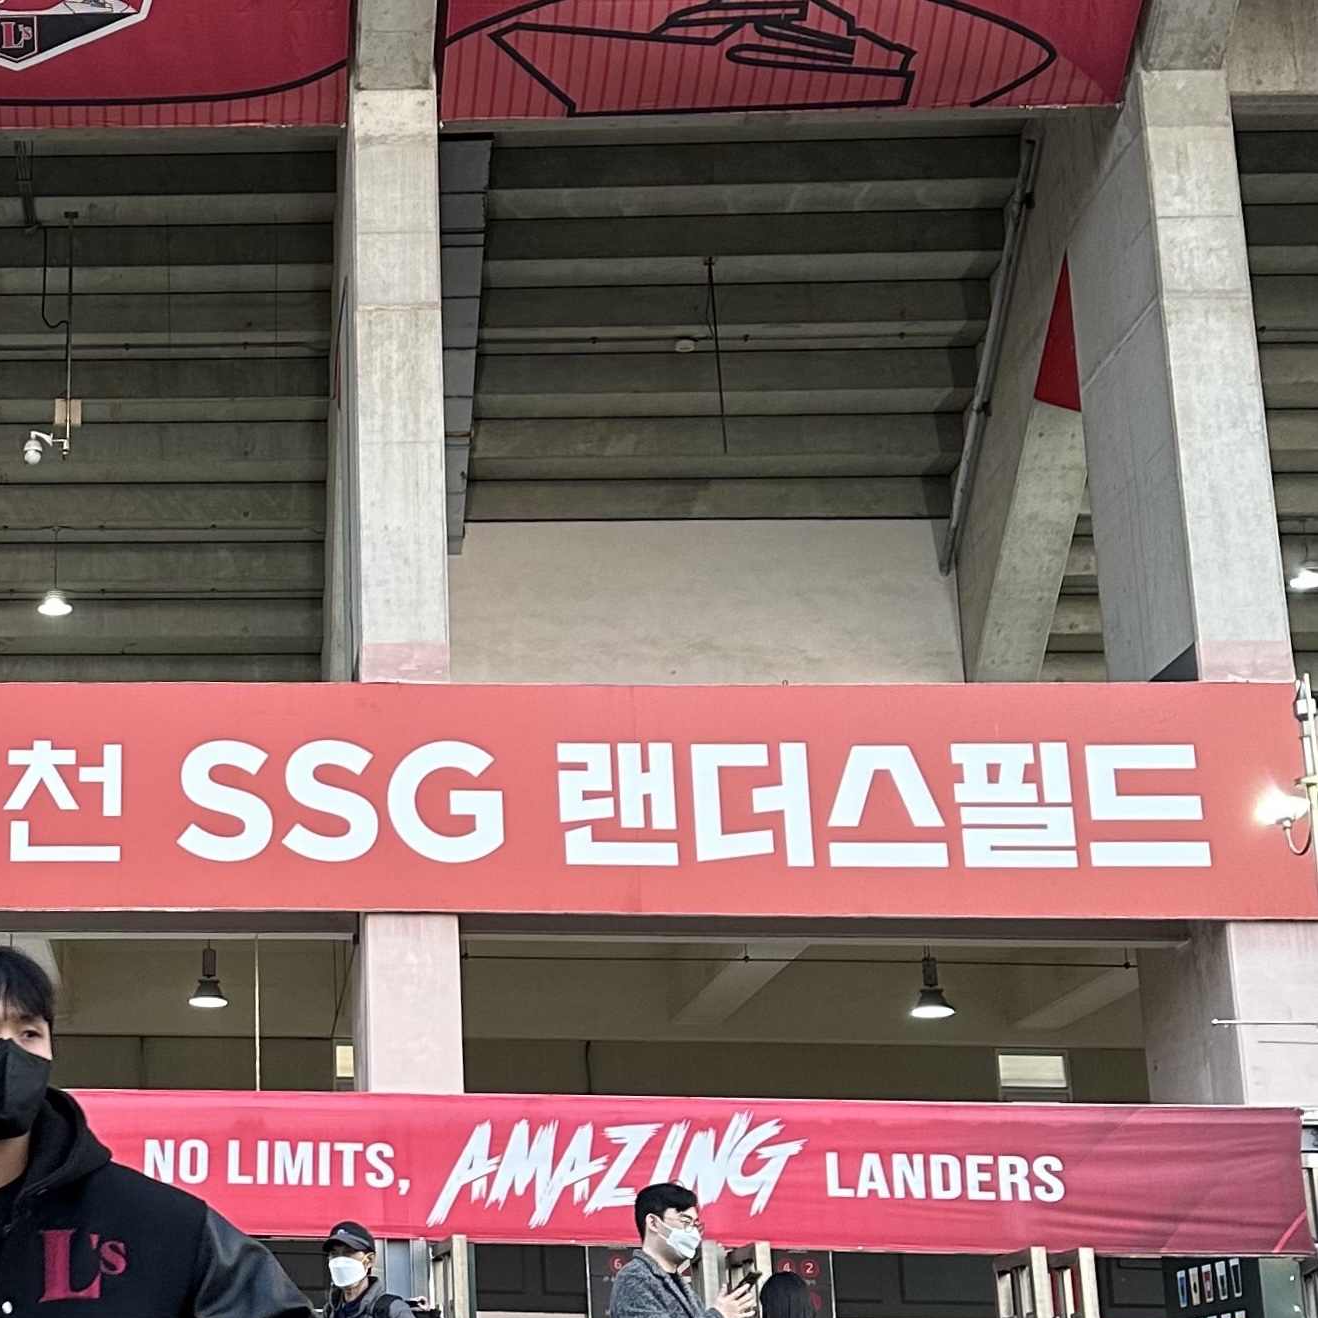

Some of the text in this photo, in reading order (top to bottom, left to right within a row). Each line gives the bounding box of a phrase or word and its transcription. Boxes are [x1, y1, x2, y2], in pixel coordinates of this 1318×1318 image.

[1, 22, 33, 49] L's
[176, 739, 505, 863] SSG
[556, 741, 1213, 868] 랜더스필드
[143, 1109, 1066, 1228] NO LIMITS, AMAZING LANDERS
[38, 1228, 128, 1303] L's
[613, 1258, 623, 1270] 6
[805, 1262, 814, 1274] 2
